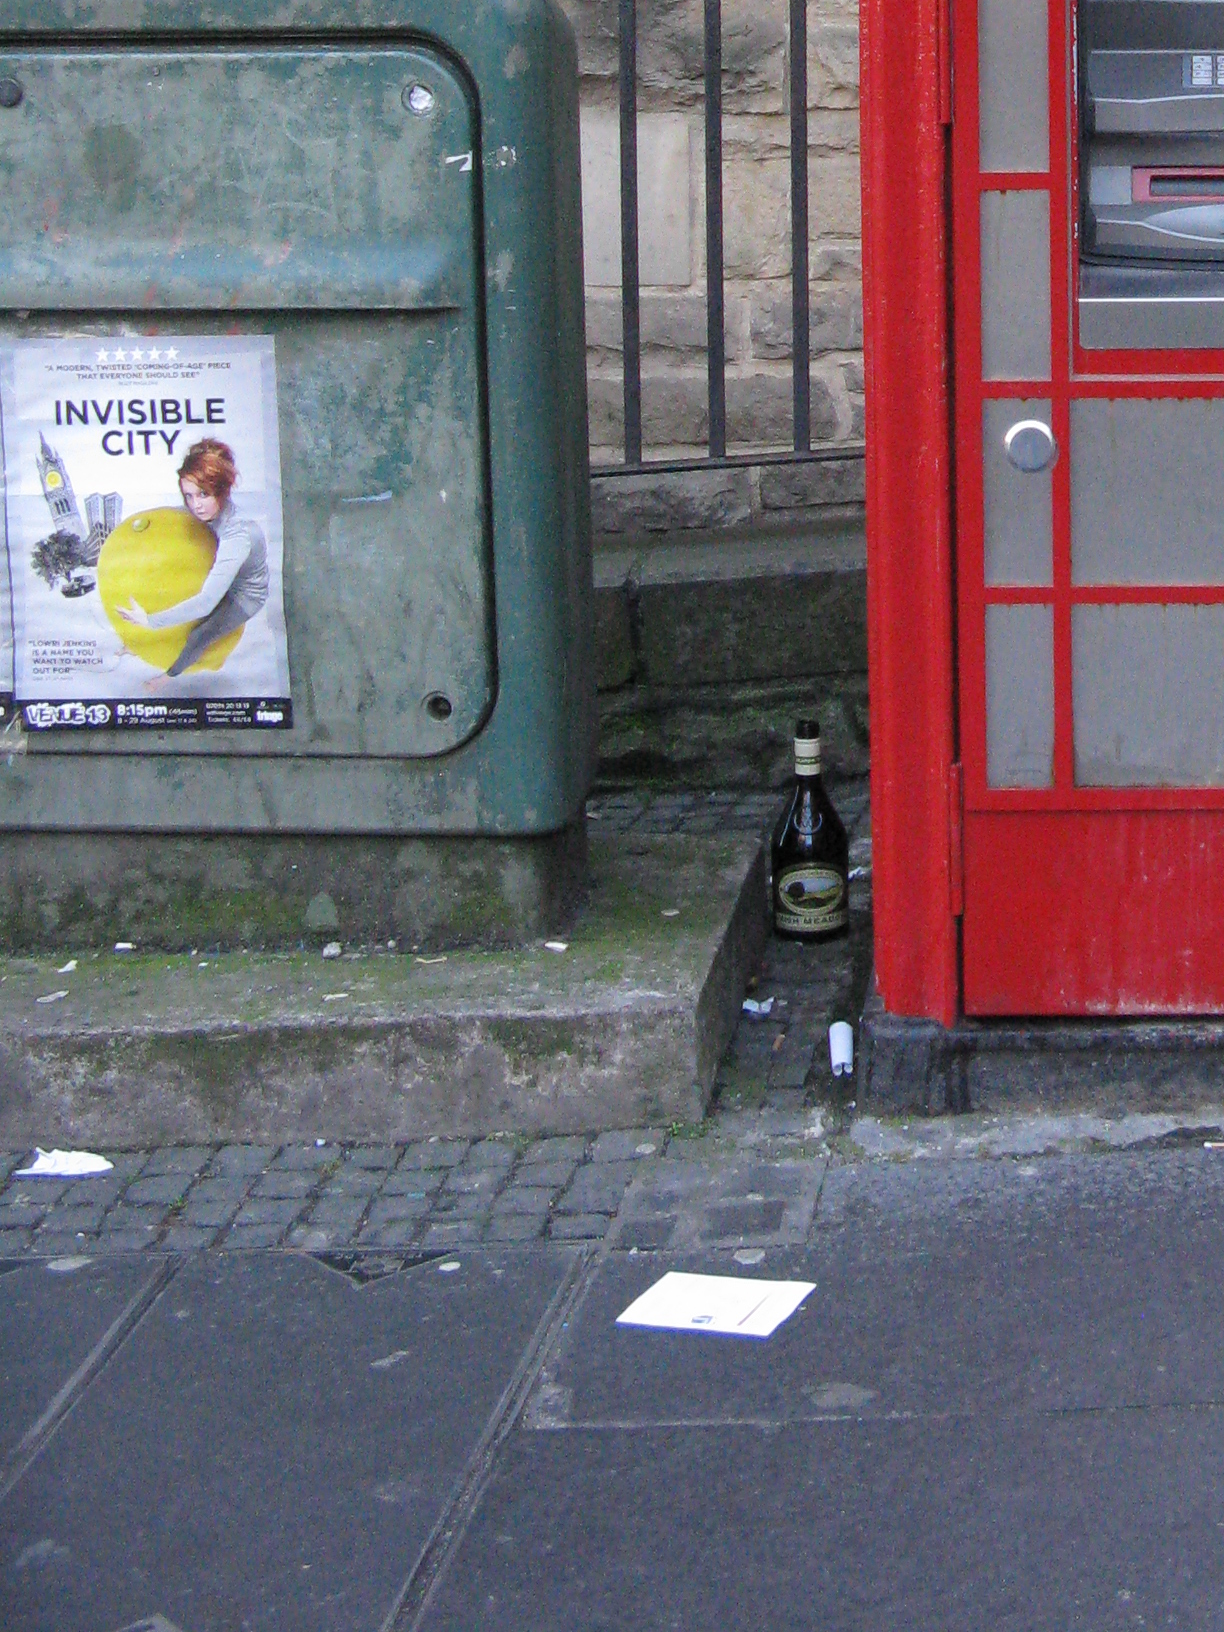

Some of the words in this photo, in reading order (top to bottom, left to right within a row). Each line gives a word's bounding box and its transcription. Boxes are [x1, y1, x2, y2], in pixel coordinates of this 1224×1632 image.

[54, 398, 226, 426] INVISIBLE
[101, 430, 182, 456] CITY
[26, 703, 86, 726] VENUE
[86, 704, 111, 724] 13
[117, 704, 168, 718] 8:15pm
[256, 710, 283, 722] fringe
